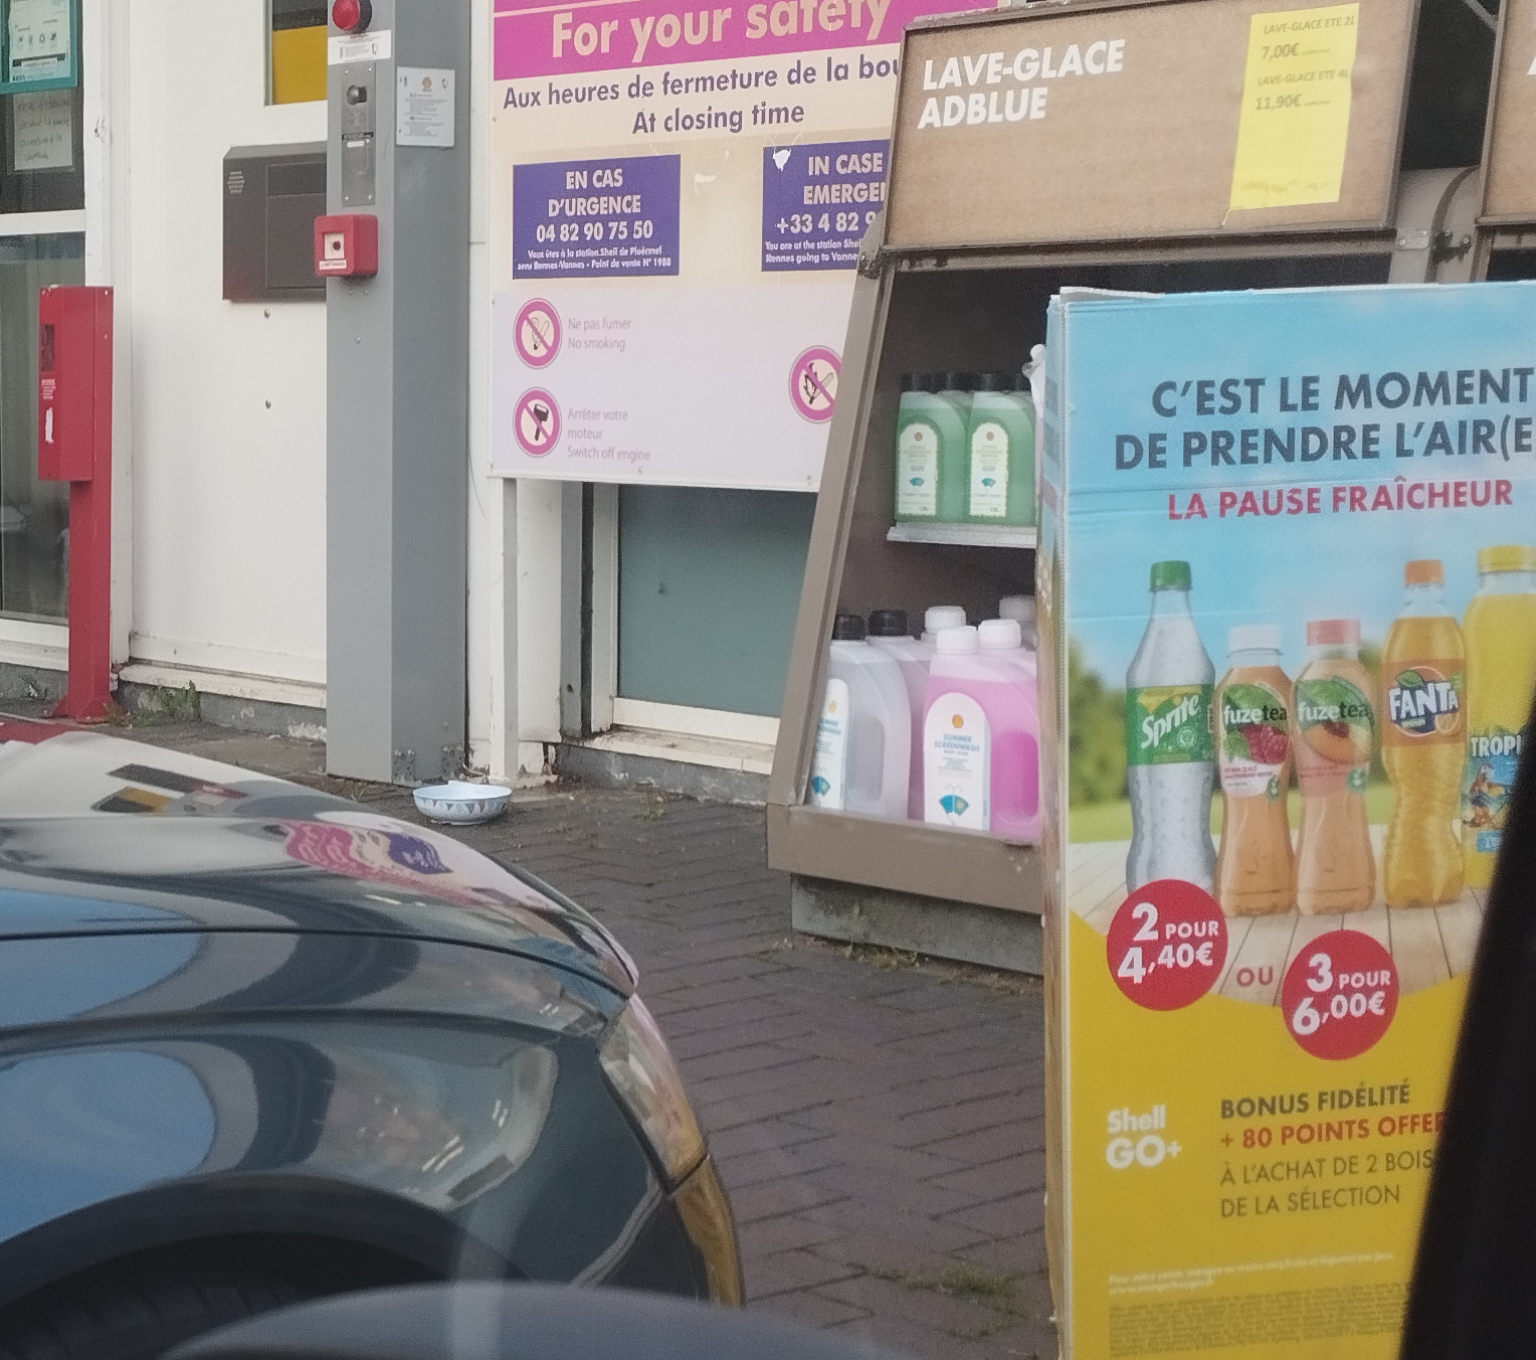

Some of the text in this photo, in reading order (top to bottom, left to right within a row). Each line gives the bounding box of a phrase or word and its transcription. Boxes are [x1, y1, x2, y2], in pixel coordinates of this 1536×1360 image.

[552, 12, 618, 58] For
[632, 5, 732, 63] your
[1264, 19, 1323, 35] LAVE-GLACE
[1324, 16, 1342, 29] ETE
[923, 38, 1126, 92] LAVE-GLACE
[1261, 42, 1300, 62] 7,00€
[503, 87, 542, 110] Aux
[547, 82, 620, 107] heures
[627, 74, 655, 99] de
[662, 64, 778, 96] fermeture
[786, 60, 817, 85] de
[825, 57, 850, 81] la
[1257, 71, 1317, 86] LAVE-GLACE
[1318, 69, 1335, 81] ETE
[917, 87, 1048, 130] ADBLUE
[1255, 93, 1302, 111] 11,90€
[632, 100, 805, 135] At closing time
[808, 152, 884, 176] IN CASE
[566, 168, 623, 190] EN CAS
[548, 194, 642, 218] D'URGENCE
[536, 219, 654, 243] 04 82 90 75 50
[776, 213, 813, 234] +33
[817, 213, 830, 233] 4
[835, 211, 859, 232] 82
[765, 240, 779, 251] You
[802, 239, 815, 250] the
[796, 252, 820, 264] going
[821, 252, 830, 261] to
[568, 316, 632, 333] Ne pas fumer
[568, 336, 626, 353] No smoking
[1152, 367, 1535, 418] C'EST LE MOMENT
[603, 409, 629, 422] votre
[567, 428, 603, 440] moteur
[1115, 414, 1536, 471] DE PRENDRE L'AIR(E
[567, 445, 652, 464] Switch off engine
[1168, 474, 1513, 521] LA PAUSE FRAÎCHEUR
[1223, 704, 1288, 726] fuzetea
[1297, 702, 1369, 722] fuzetea
[1388, 682, 1459, 721] FANTA
[1140, 694, 1202, 750] Sprite
[1131, 902, 1220, 941] 2 POUR
[1117, 941, 1214, 984] 4,40€
[1235, 966, 1274, 988] OU
[1307, 953, 1392, 992] 3 POUR
[1292, 991, 1386, 1036] 6,00€
[1221, 1078, 1410, 1119] BONUS FIDÉLITÉ
[1106, 1105, 1166, 1134] Shell
[1221, 1133, 1234, 1148] +
[1242, 1127, 1273, 1149] 80
[1281, 1118, 1370, 1146] POINTS
[1105, 1134, 1182, 1170] GO+
[1220, 1160, 1236, 1187] À
[1243, 1158, 1327, 1185] L'ACHAT
[1333, 1155, 1359, 1177] DE
[1365, 1153, 1378, 1173] 2
[1221, 1184, 1401, 1218] DE LA SÉLECTION
